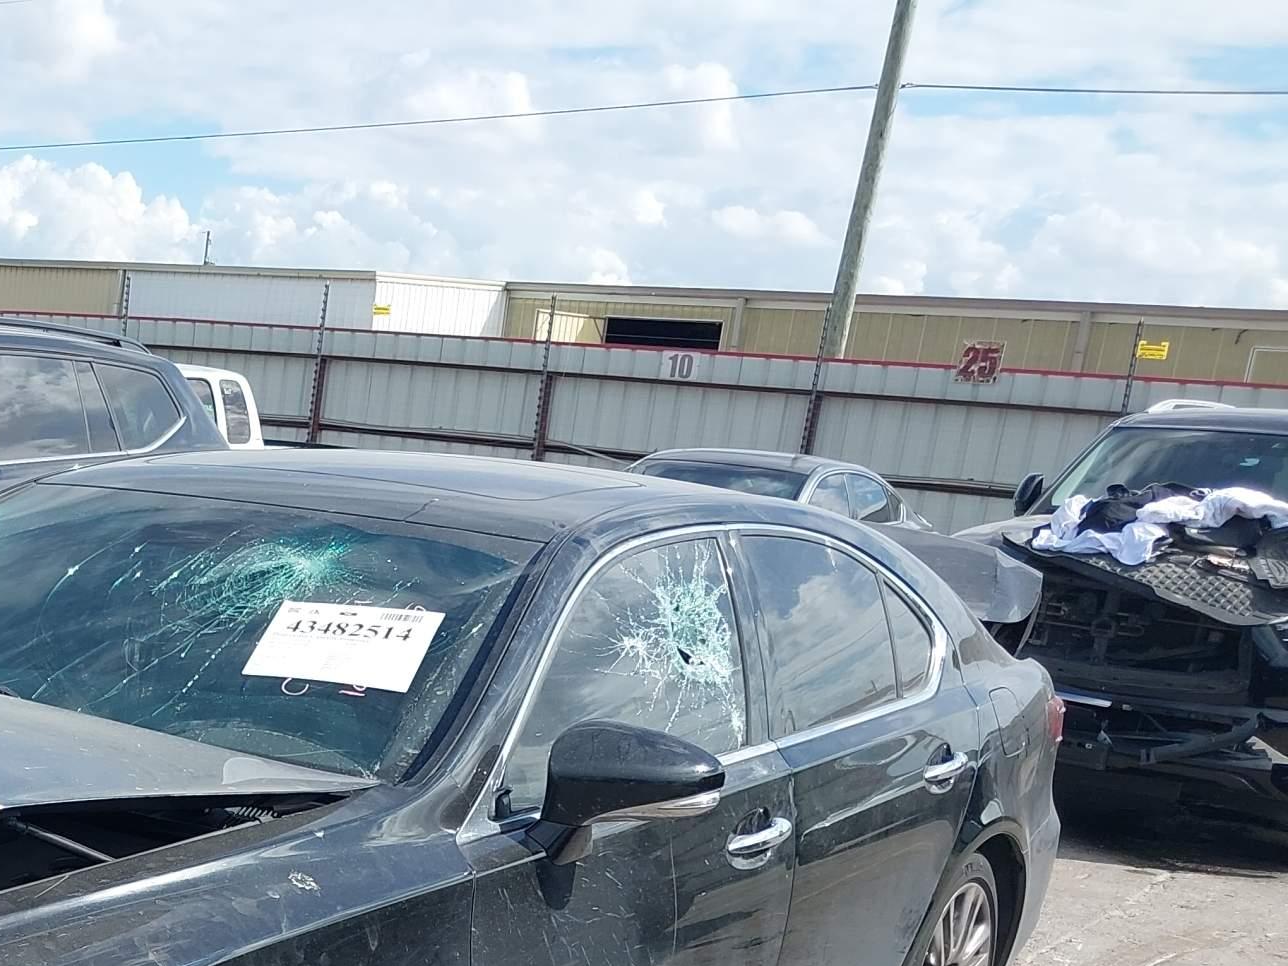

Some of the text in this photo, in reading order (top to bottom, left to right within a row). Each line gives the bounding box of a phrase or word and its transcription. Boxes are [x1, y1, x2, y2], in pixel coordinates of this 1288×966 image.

[668, 353, 694, 379] 10
[957, 346, 1000, 378] 25
[286, 619, 413, 641] 43482514
